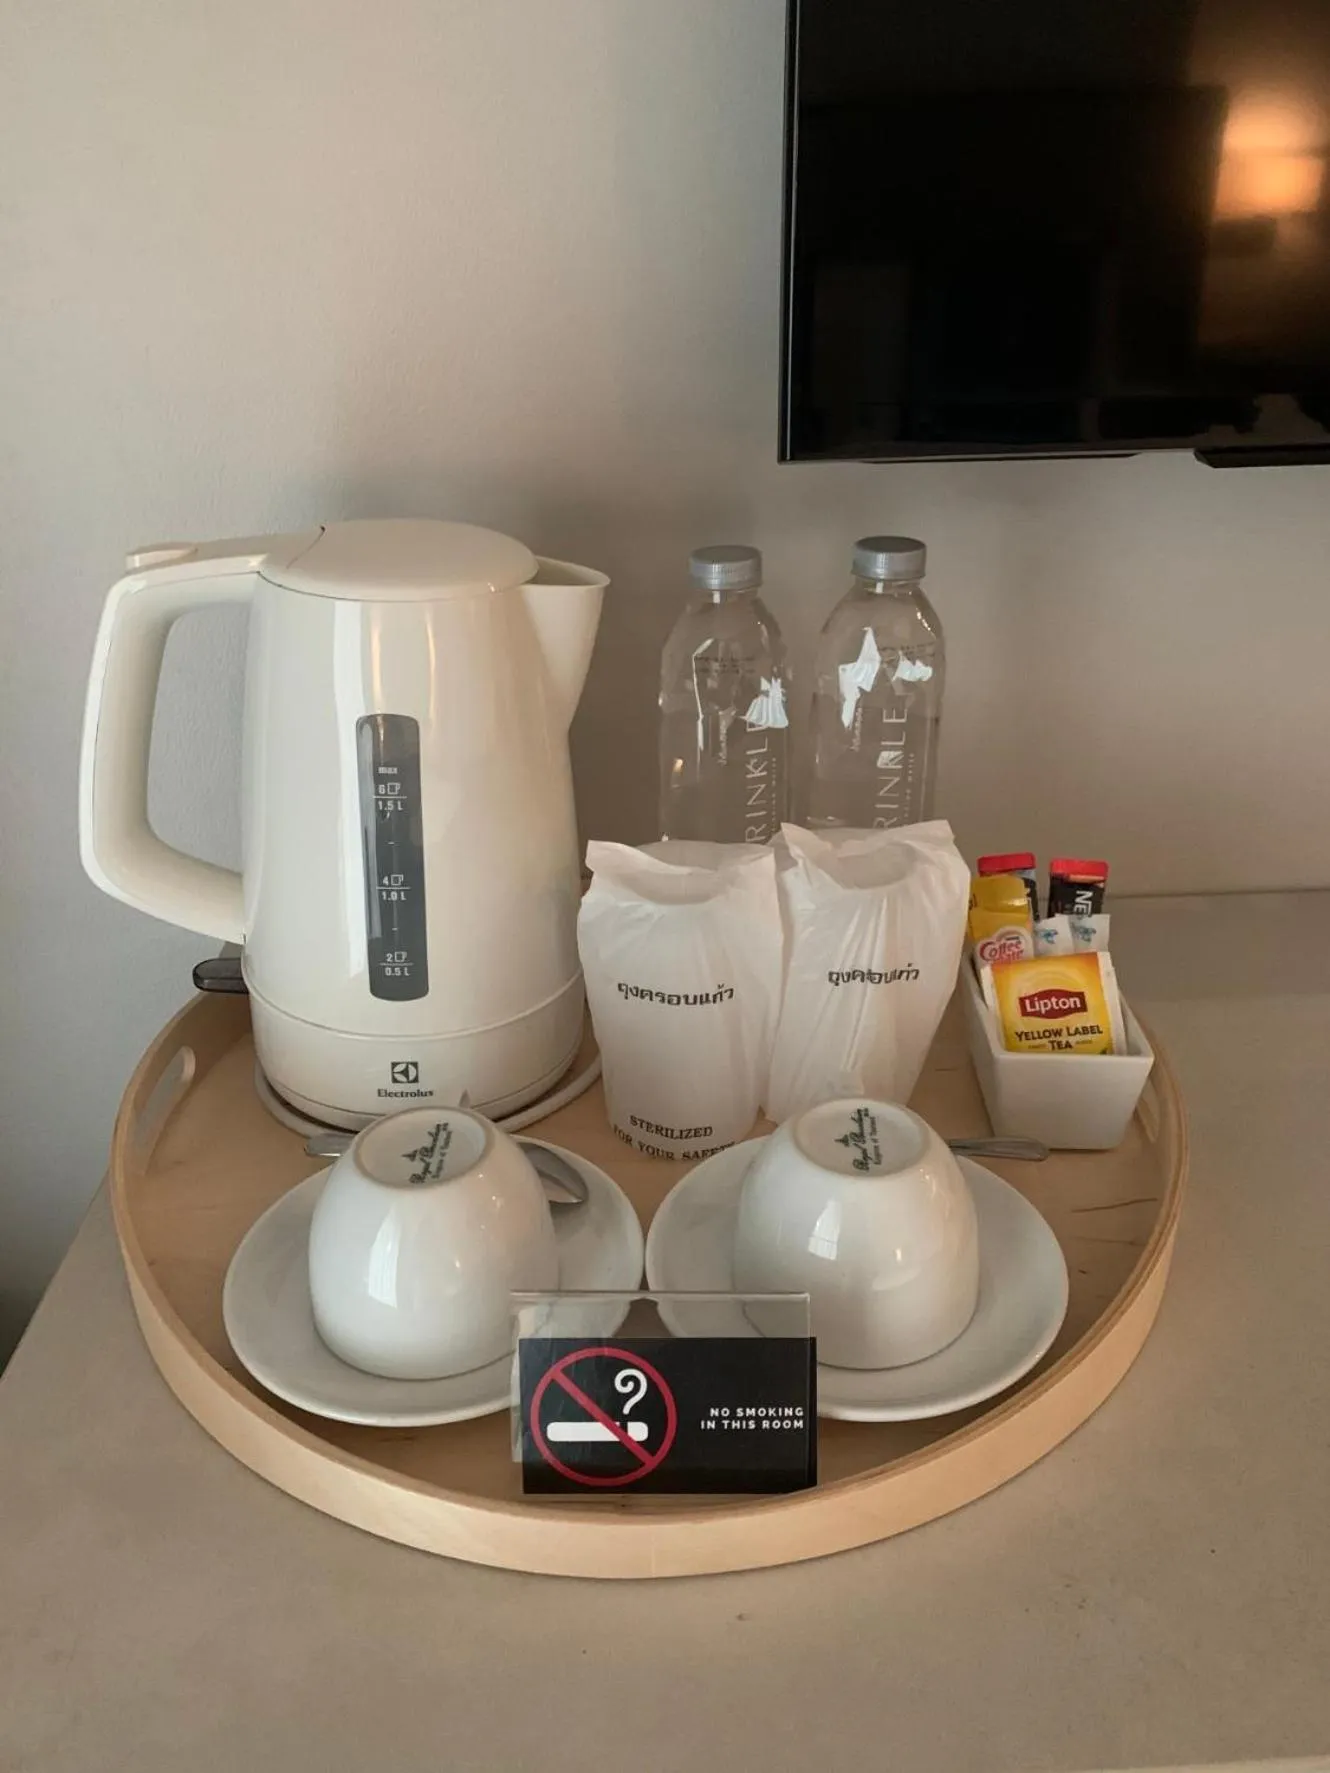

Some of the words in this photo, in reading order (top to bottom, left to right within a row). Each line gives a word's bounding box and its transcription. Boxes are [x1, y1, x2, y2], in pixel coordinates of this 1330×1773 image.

[378, 766, 398, 774] max
[378, 801, 394, 811] 1.5
[397, 800, 404, 811] L
[382, 876, 389, 886] 4
[382, 891, 398, 901] 1.0
[401, 891, 407, 900] L
[386, 953, 393, 962] 2
[385, 967, 402, 976] 0.5
[404, 967, 410, 976] L
[1025, 996, 1081, 1015] Lipton
[1015, 1028, 1063, 1041] YELLOW
[1066, 1024, 1104, 1037] LABEL
[1048, 1040, 1073, 1051] TEA
[377, 1088, 434, 1098] Electrolux
[630, 1115, 714, 1140] STERILIZED
[637, 1141, 675, 1161] YOUR
[710, 1407, 730, 1417] NO
[736, 1407, 804, 1417] SMOKING
[700, 1420, 716, 1430] IN
[722, 1420, 756, 1430] THIS
[762, 1420, 804, 1430] ROOM
